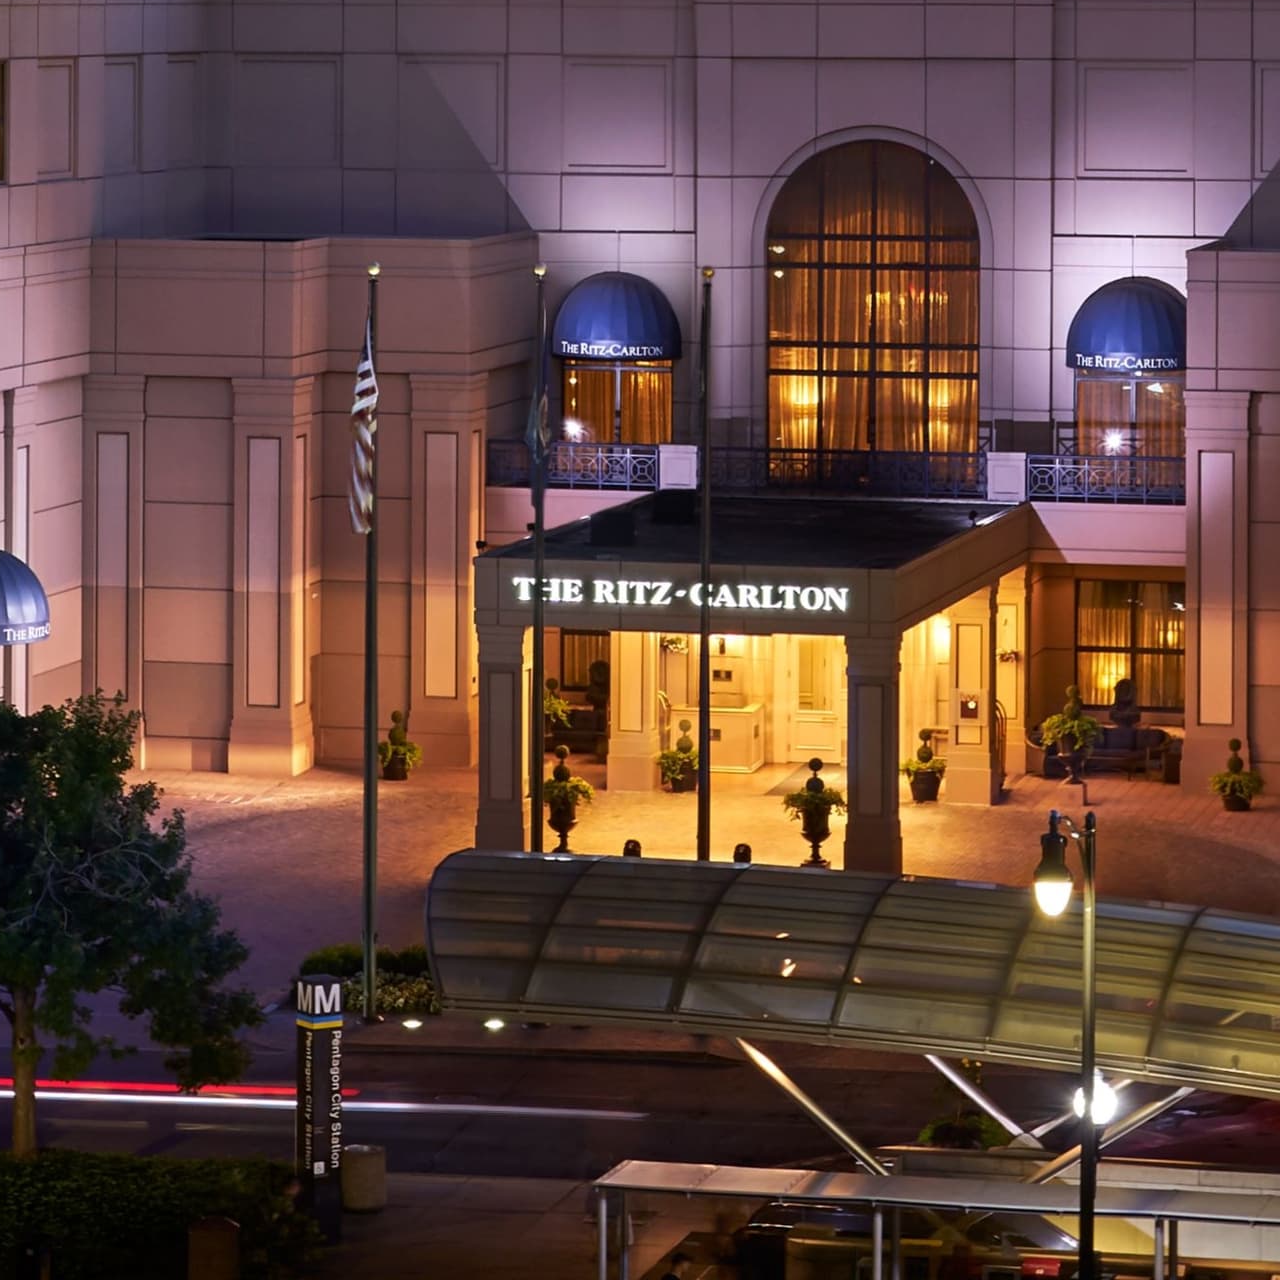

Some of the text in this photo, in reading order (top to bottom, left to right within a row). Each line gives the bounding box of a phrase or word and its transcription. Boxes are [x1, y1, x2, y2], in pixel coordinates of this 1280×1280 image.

[561, 341, 663, 357] THE RITZ-CARLTON
[1076, 353, 1178, 369] THE RITZ-CARLTON
[512, 577, 848, 612] THE RITZ-CARLTON
[315, 983, 341, 1015] M
[329, 1030, 342, 1169] Pentagon City Station
